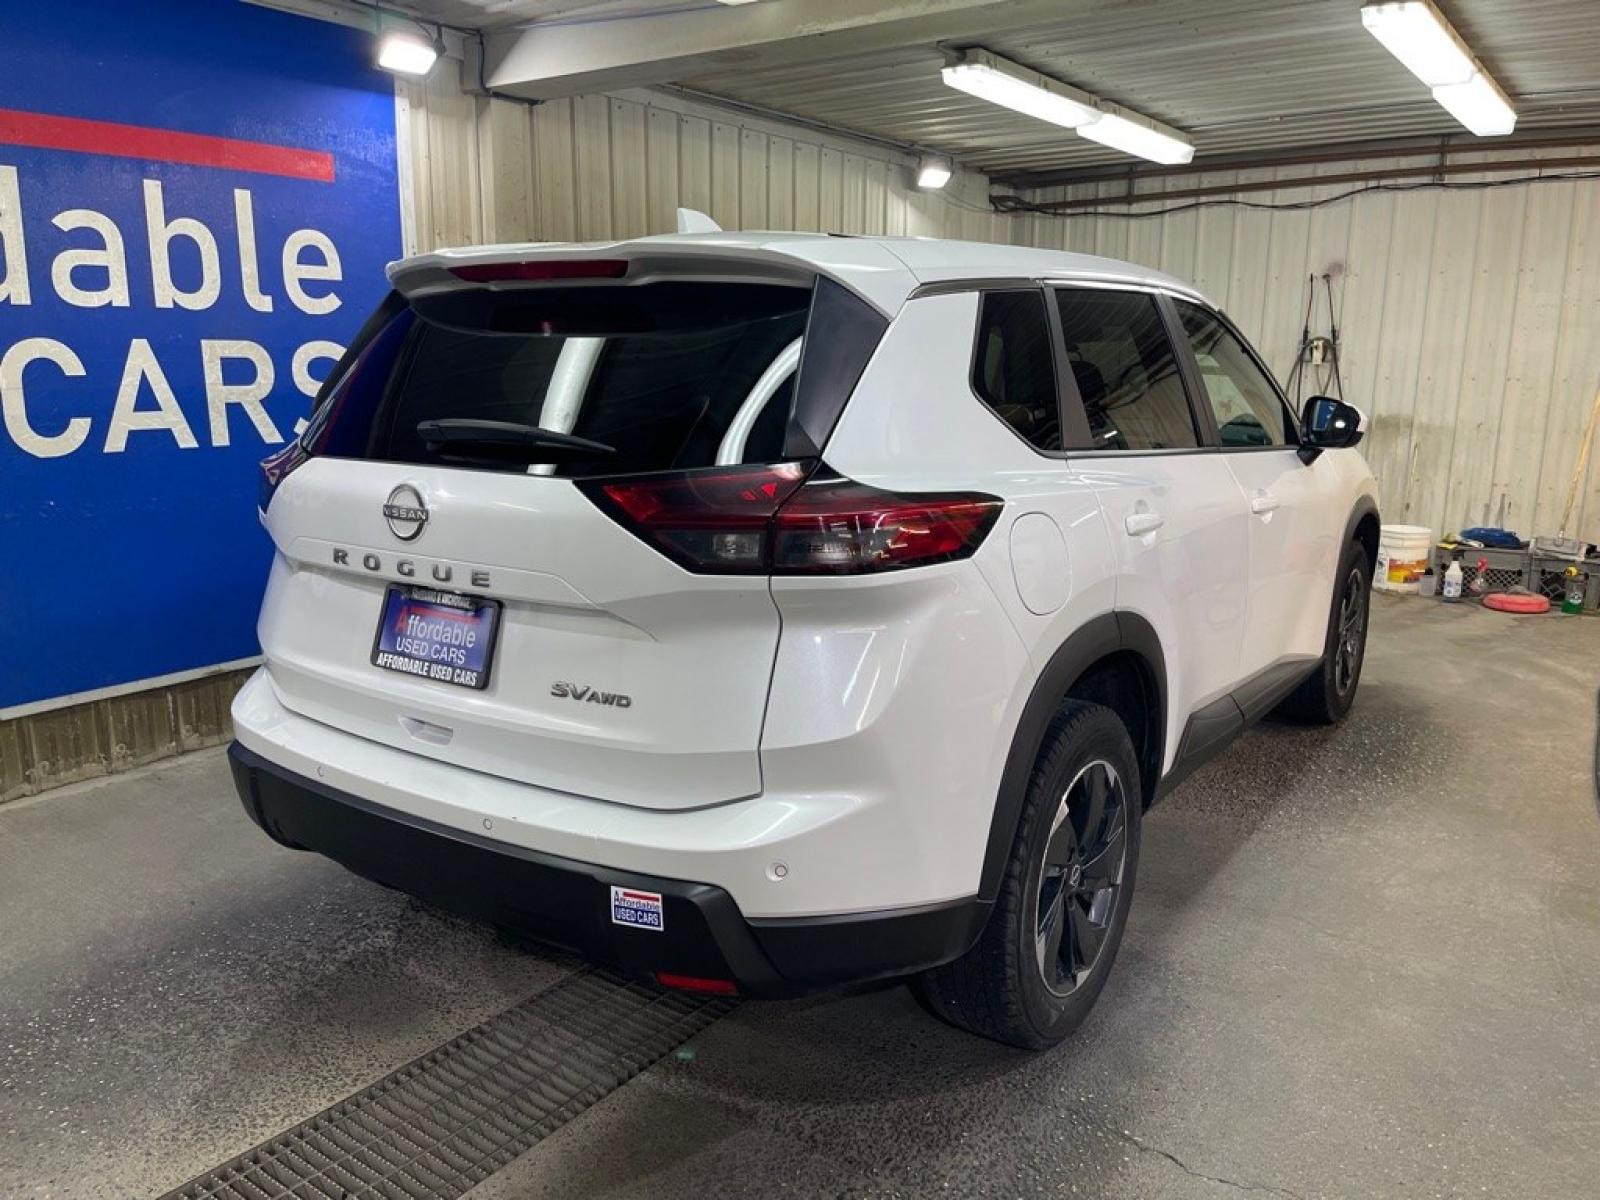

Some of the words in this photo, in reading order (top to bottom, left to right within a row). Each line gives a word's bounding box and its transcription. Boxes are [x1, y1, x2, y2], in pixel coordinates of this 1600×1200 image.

[333, 547, 490, 588] ROGUE
[395, 607, 476, 648] Affordable
[396, 636, 429, 656] USED
[431, 644, 467, 665] CARS
[377, 652, 429, 676] AFFORDABLE
[430, 663, 453, 681] USED
[454, 668, 478, 687] CARS
[615, 907, 637, 921] USED
[637, 910, 659, 926] CARS
